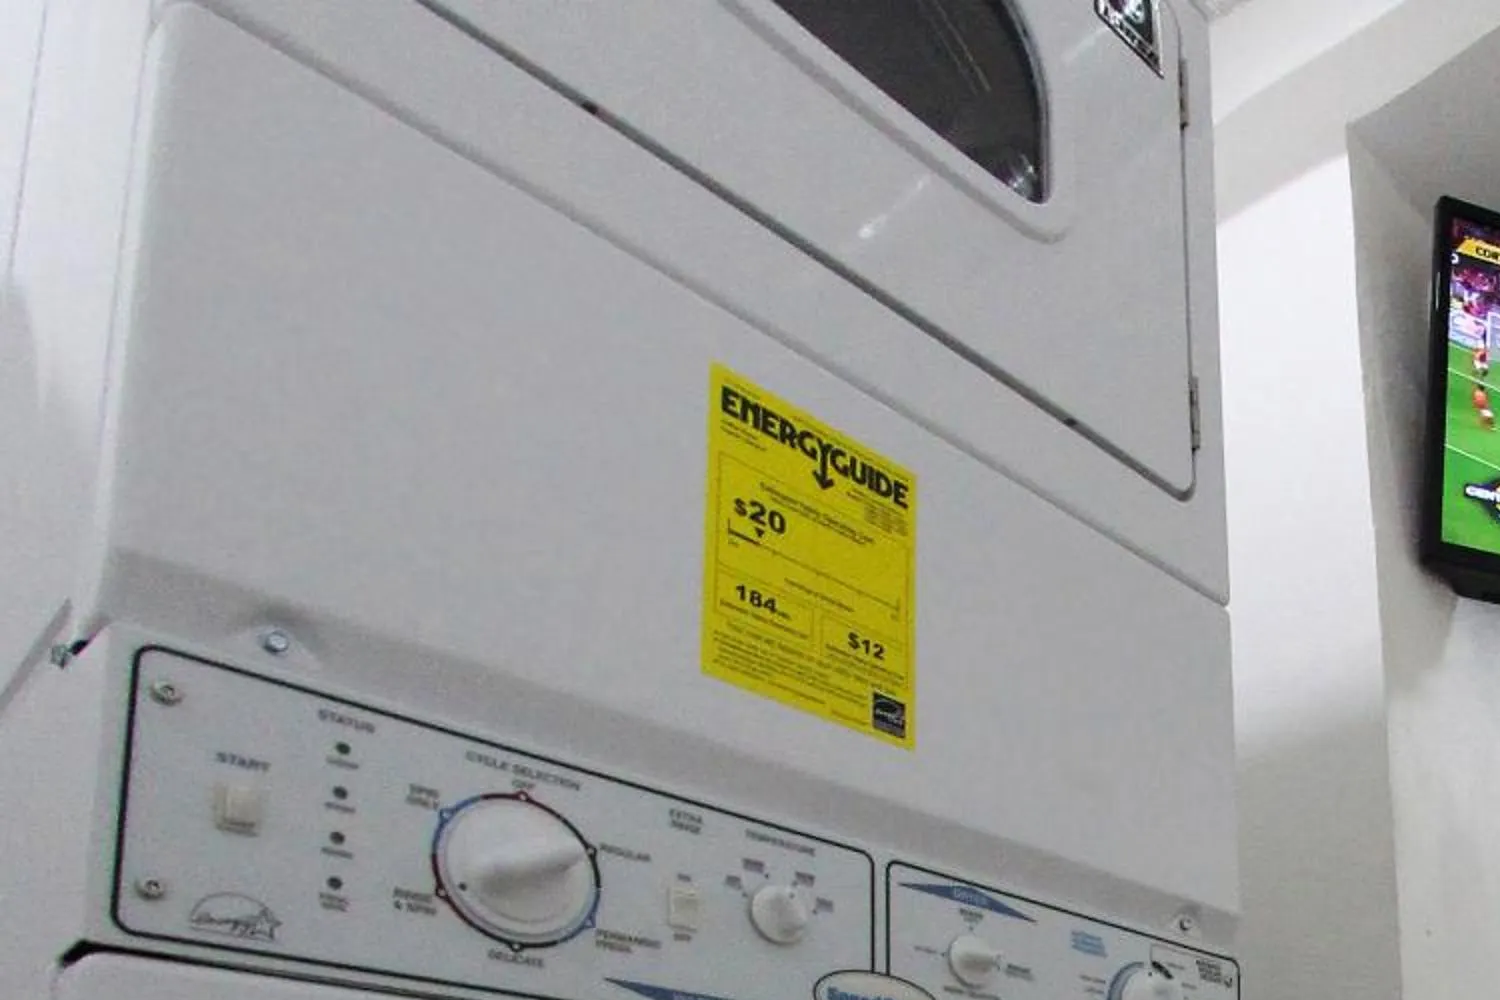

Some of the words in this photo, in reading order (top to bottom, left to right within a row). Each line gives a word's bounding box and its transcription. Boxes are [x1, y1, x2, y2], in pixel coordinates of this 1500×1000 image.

[734, 497, 786, 535] $20
[735, 583, 777, 614] 184
[847, 631, 886, 661] $12
[216, 751, 271, 772] START
